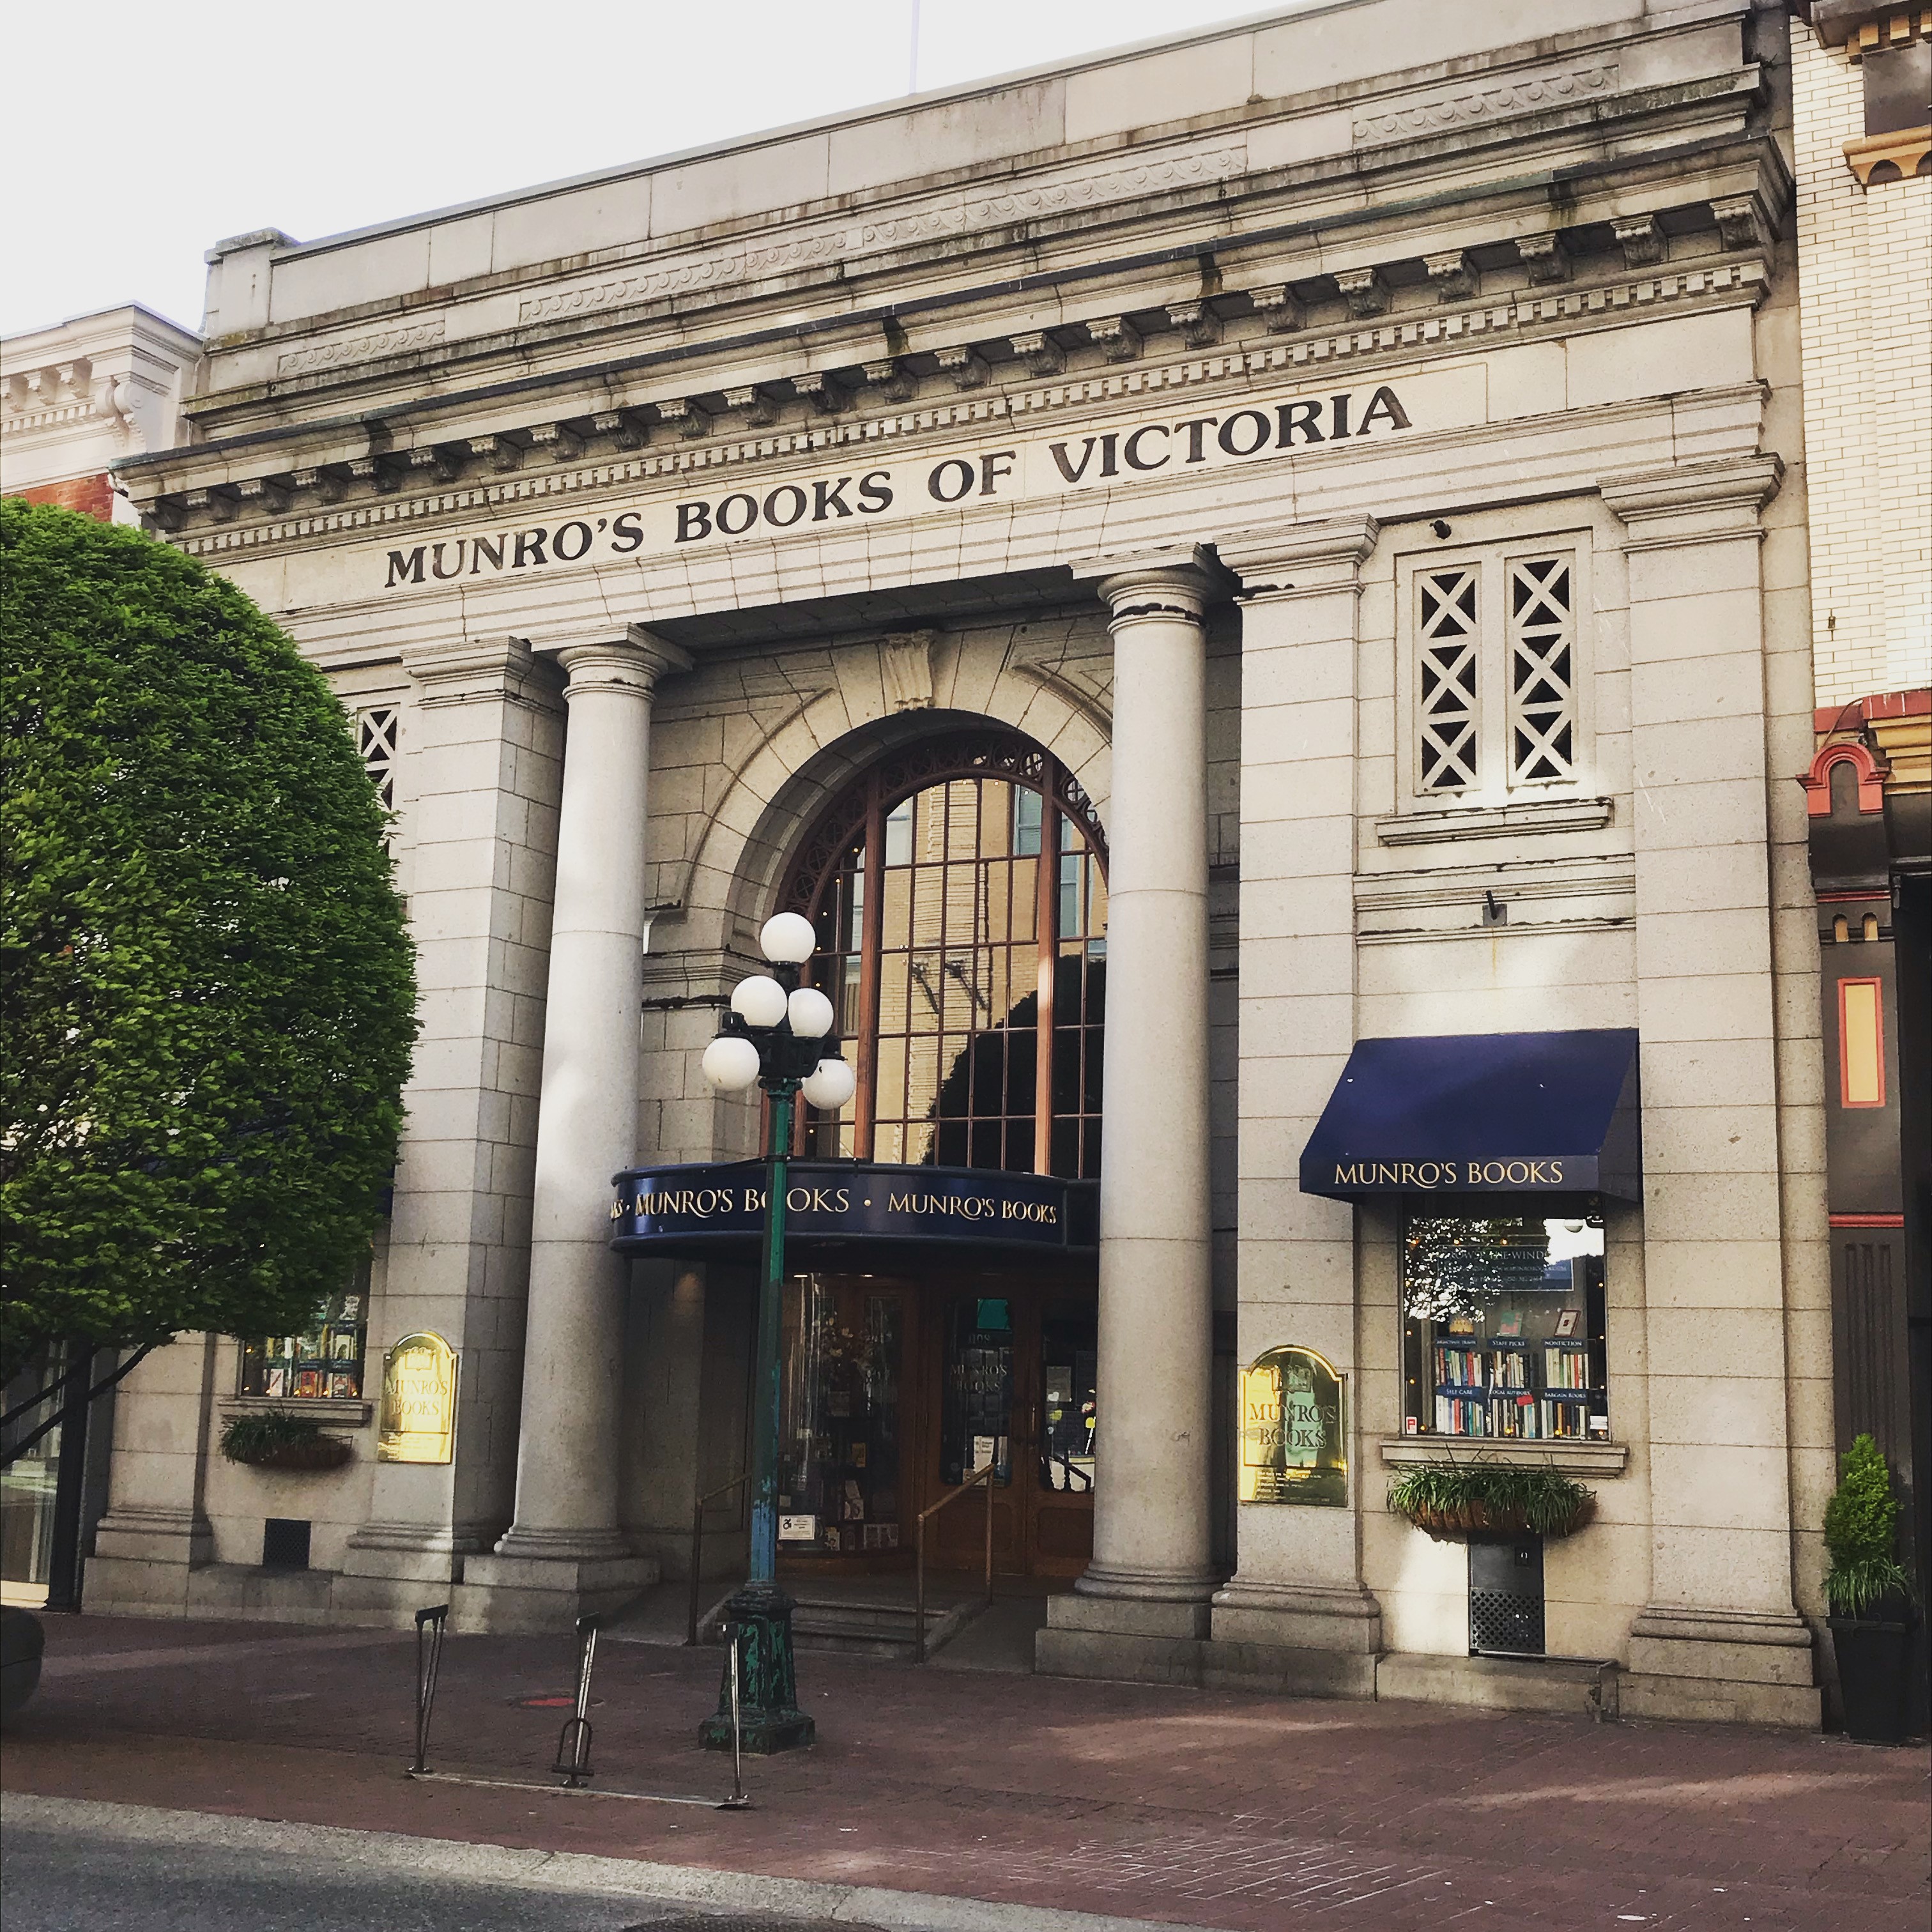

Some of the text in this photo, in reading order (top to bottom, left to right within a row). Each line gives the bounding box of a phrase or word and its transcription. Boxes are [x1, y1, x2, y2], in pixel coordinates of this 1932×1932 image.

[385, 386, 1413, 588] MUNRO'S BOOKS OF VICTORIA
[1334, 1161, 1563, 1189] MUNRO'S BOOKS
[634, 1187, 734, 1218] MUNRO'S
[743, 1188, 850, 1214] BOKS
[887, 1192, 995, 1222] MUNRO'S
[1001, 1200, 1057, 1225] BOOKS
[392, 1400, 440, 1416] BOOKS
[1249, 1402, 1337, 1423] MUNRO'S
[1259, 1427, 1327, 1449] BOOKS
